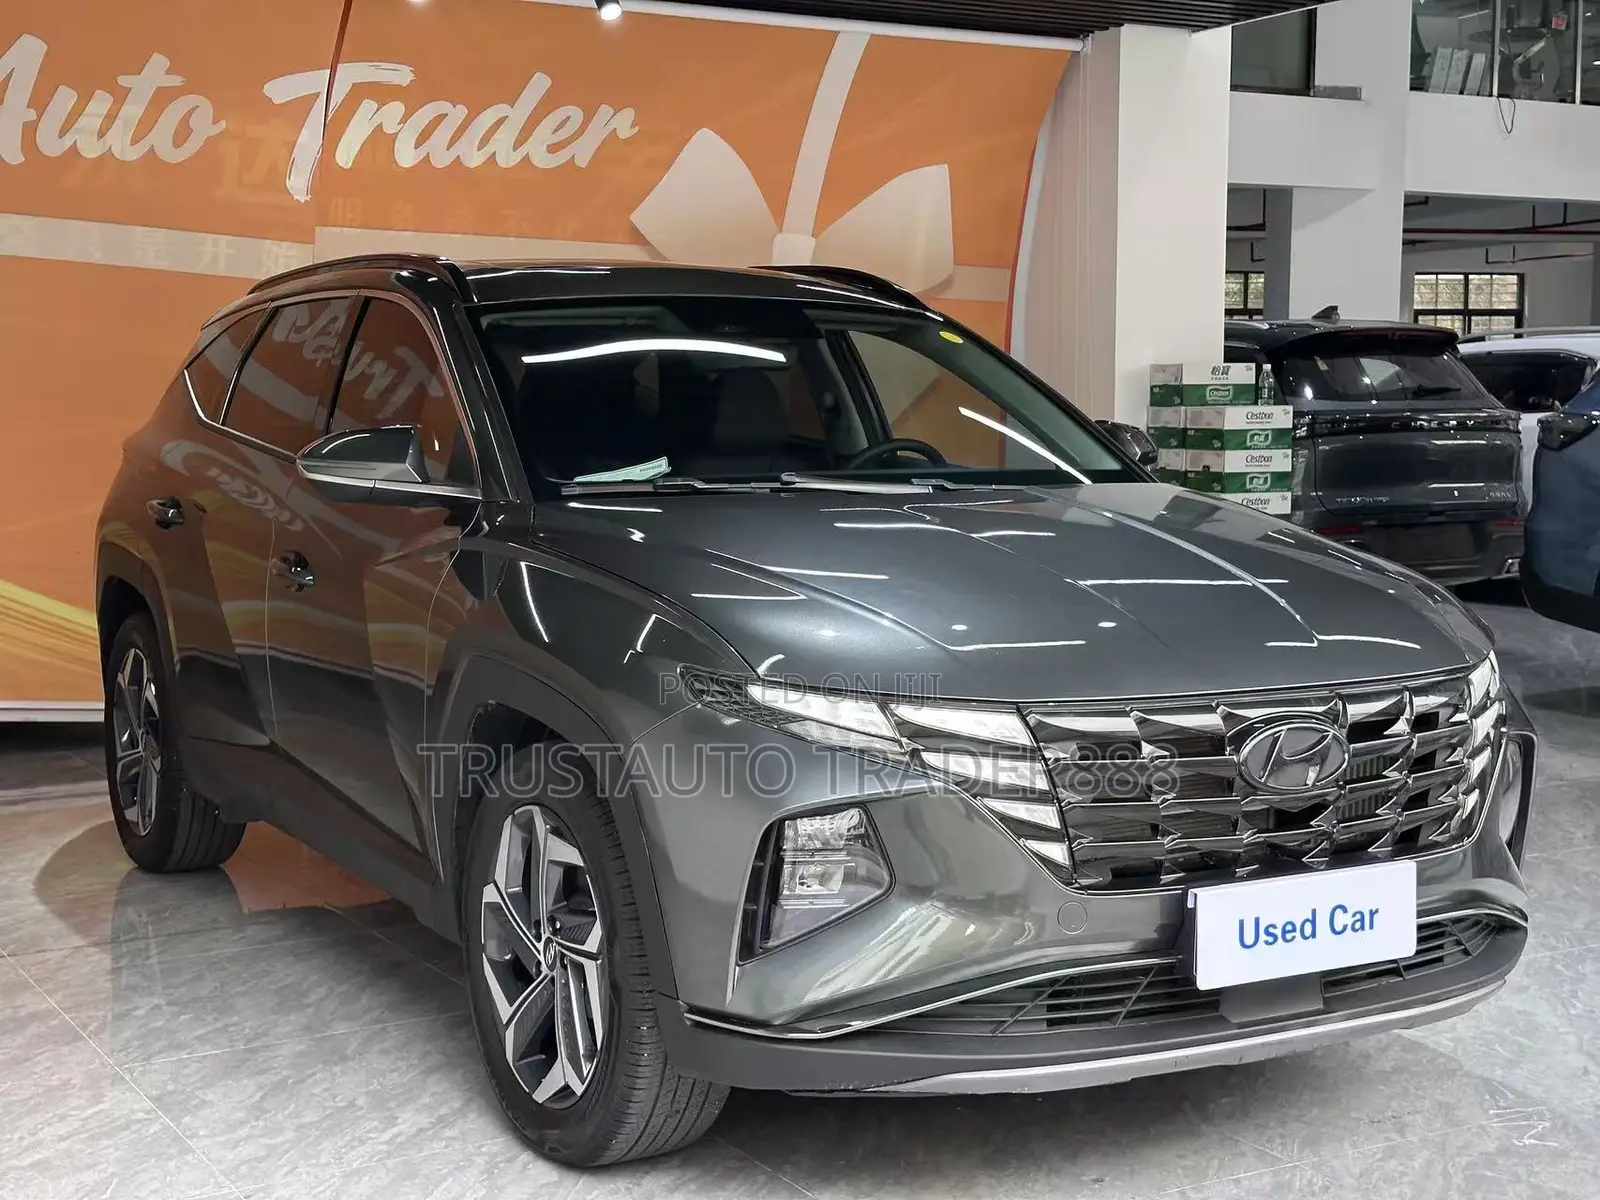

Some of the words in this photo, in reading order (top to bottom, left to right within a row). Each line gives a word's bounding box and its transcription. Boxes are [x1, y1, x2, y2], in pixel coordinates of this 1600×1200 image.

[0, 33, 225, 165] Auto
[263, 61, 639, 203] Trader
[1245, 411, 1274, 420] Cestbon
[1245, 454, 1272, 463] Cestbon
[1238, 908, 1316, 950] Used
[1328, 904, 1379, 936] Car
